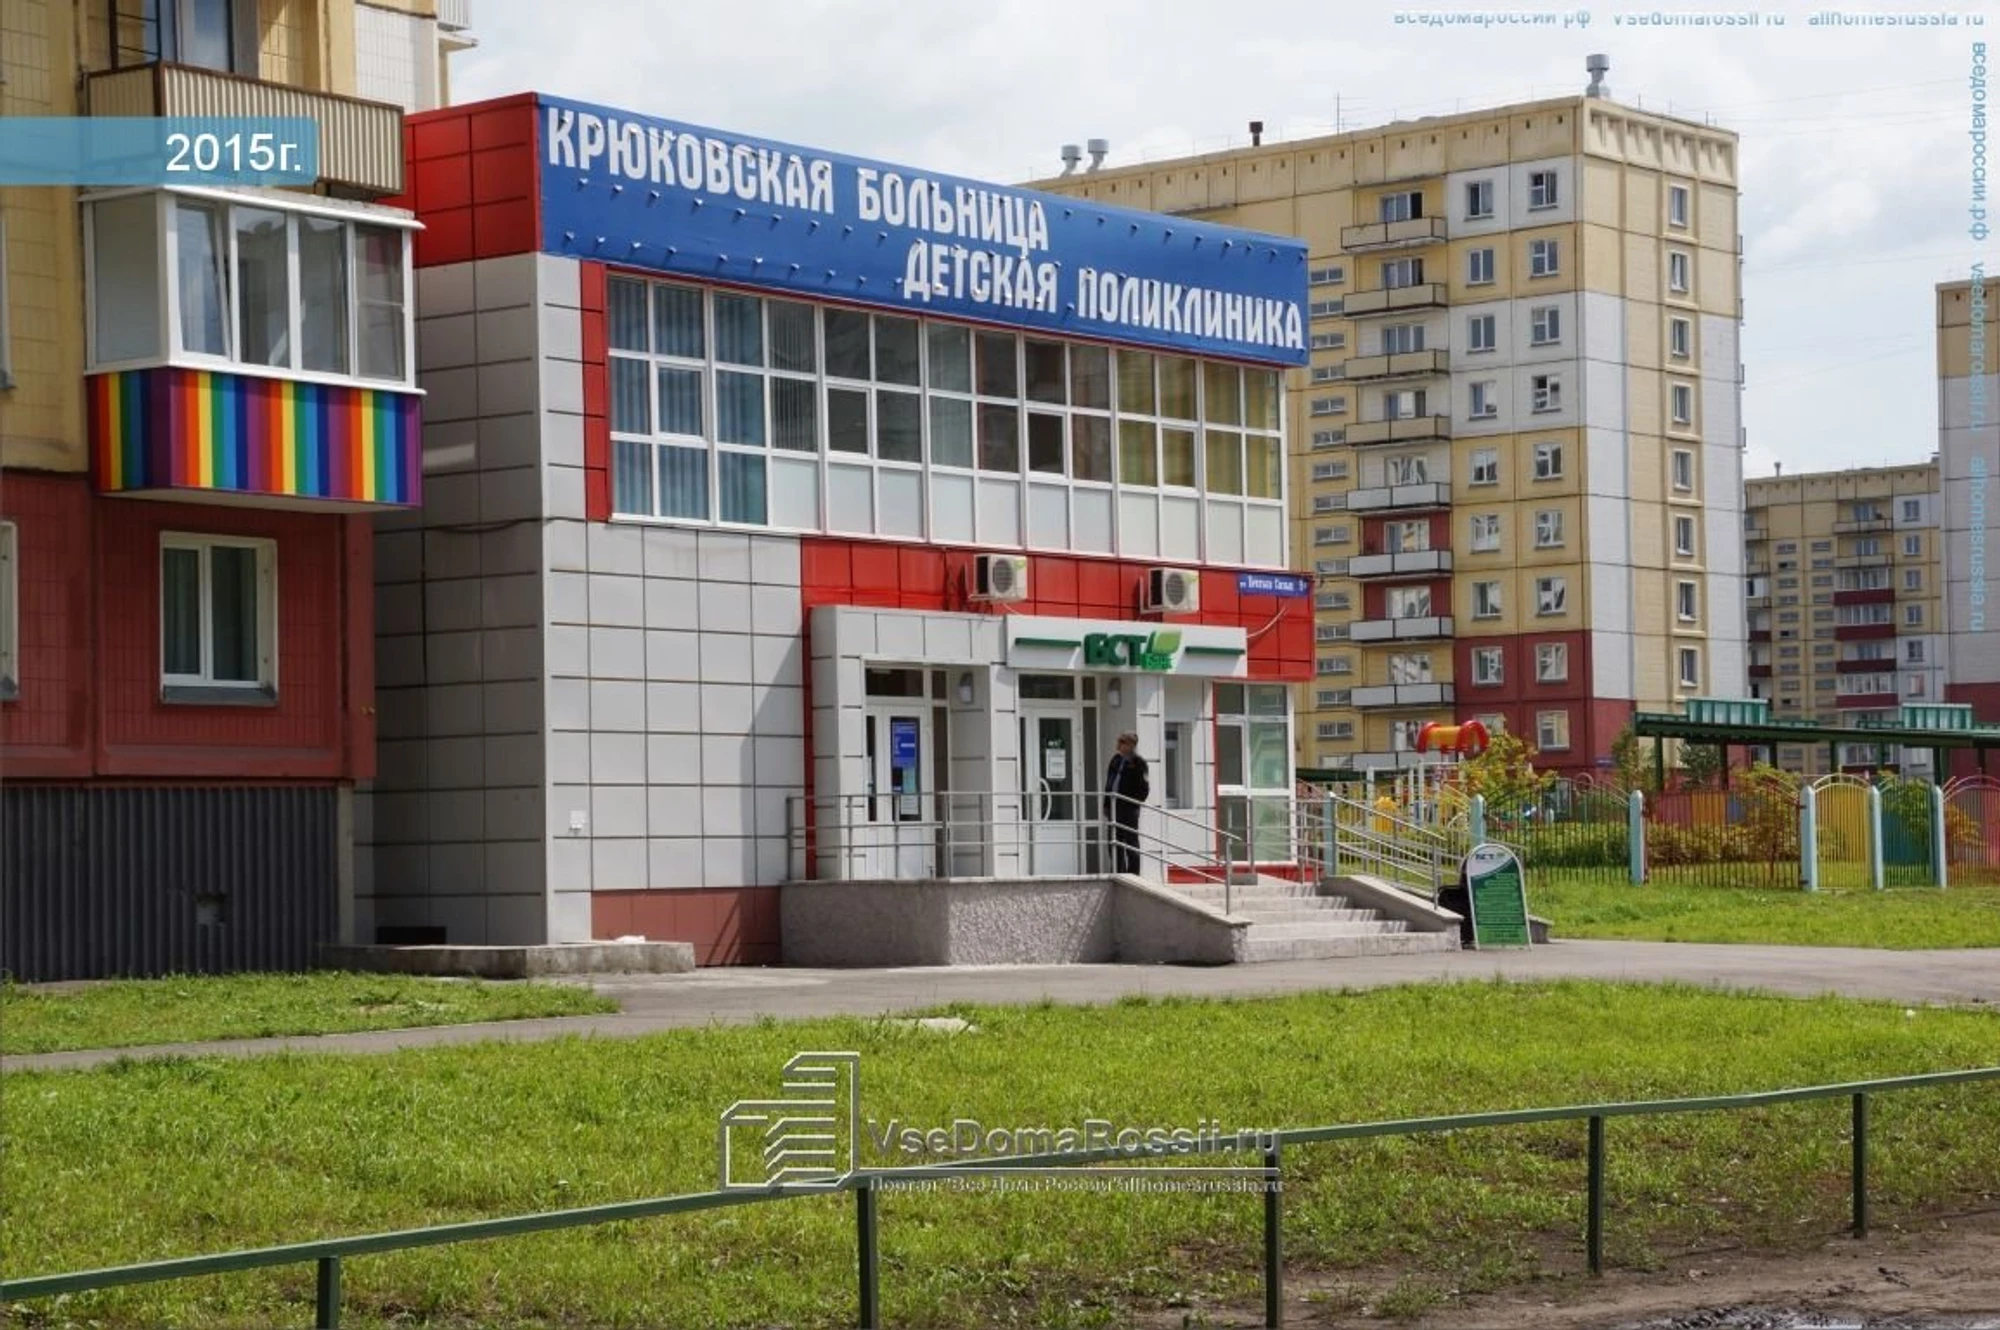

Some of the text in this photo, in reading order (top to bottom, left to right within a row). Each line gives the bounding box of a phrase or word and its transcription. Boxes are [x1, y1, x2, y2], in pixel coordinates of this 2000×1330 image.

[548, 107, 1049, 259] КРЮКОВСКАЯ БОЛЬНИЦА
[903, 238, 1304, 350] ДЕТСКАЯ ПОЛИКЛИНИКА
